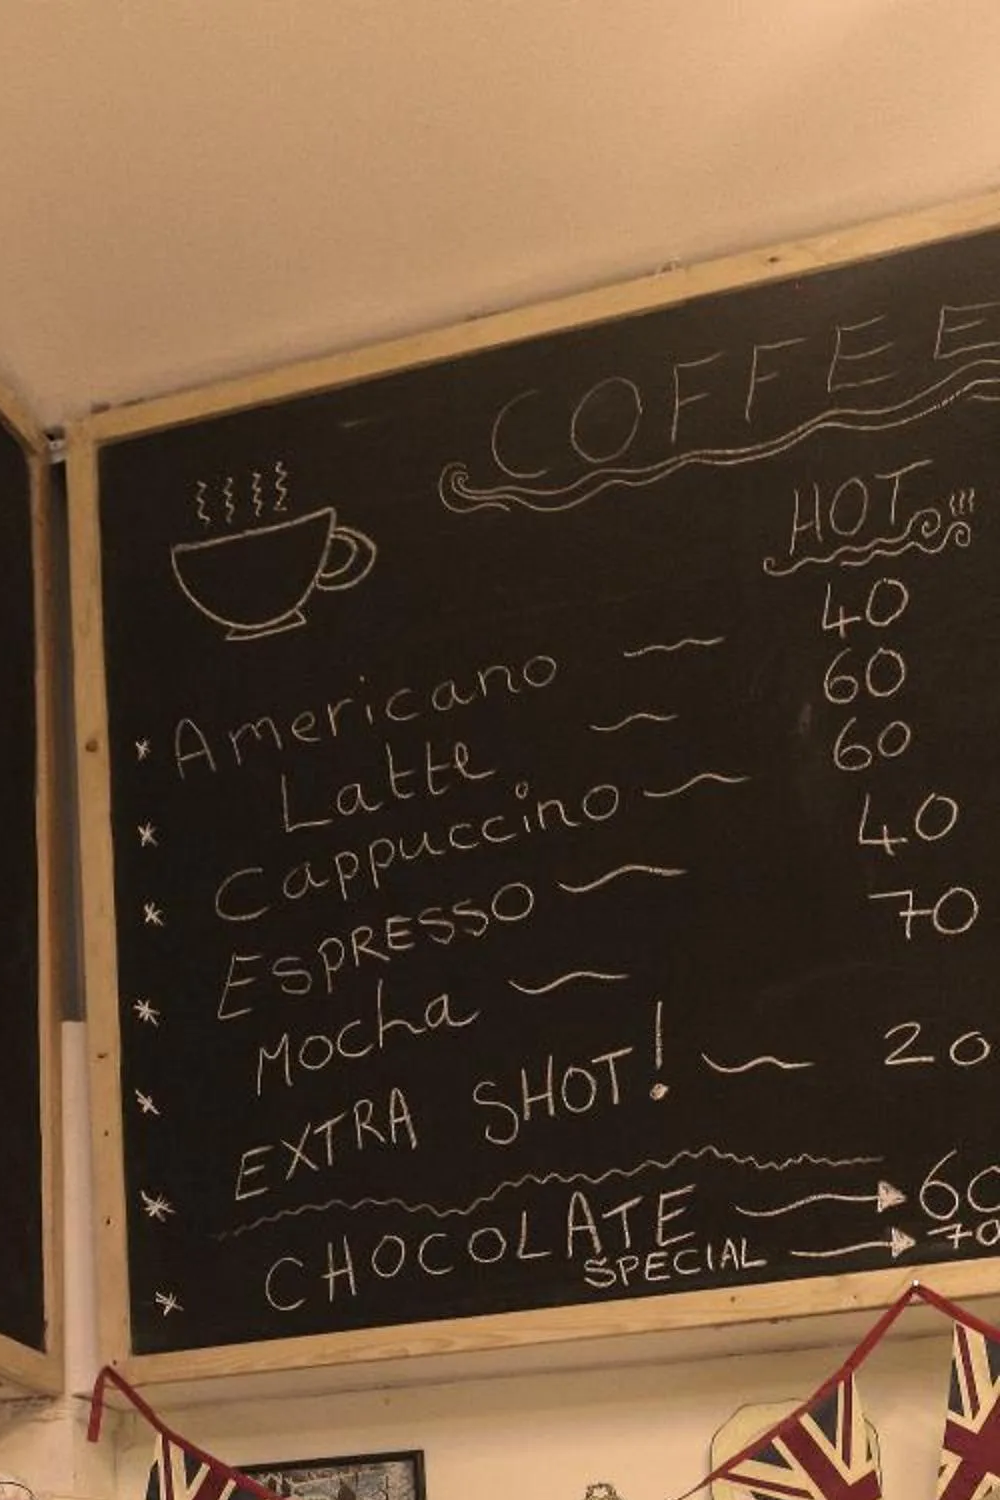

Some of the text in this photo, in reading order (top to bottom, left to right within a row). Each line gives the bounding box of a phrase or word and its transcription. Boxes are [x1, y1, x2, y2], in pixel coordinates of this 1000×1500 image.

[492, 302, 1000, 479] COFFEE
[790, 459, 934, 556] HOT
[822, 577, 910, 637] 40
[175, 648, 906, 782] Americano 60
[283, 720, 912, 835] Latte 60
[215, 782, 959, 922] Cappuccino 40
[217, 882, 979, 1021] ESPRESSO 70
[235, 1087, 418, 1202] EXTRA
[884, 1020, 992, 1067] 20
[265, 1148, 1000, 1313] CHOCOLATE 60
[585, 1237, 769, 1290] SPECIAL
